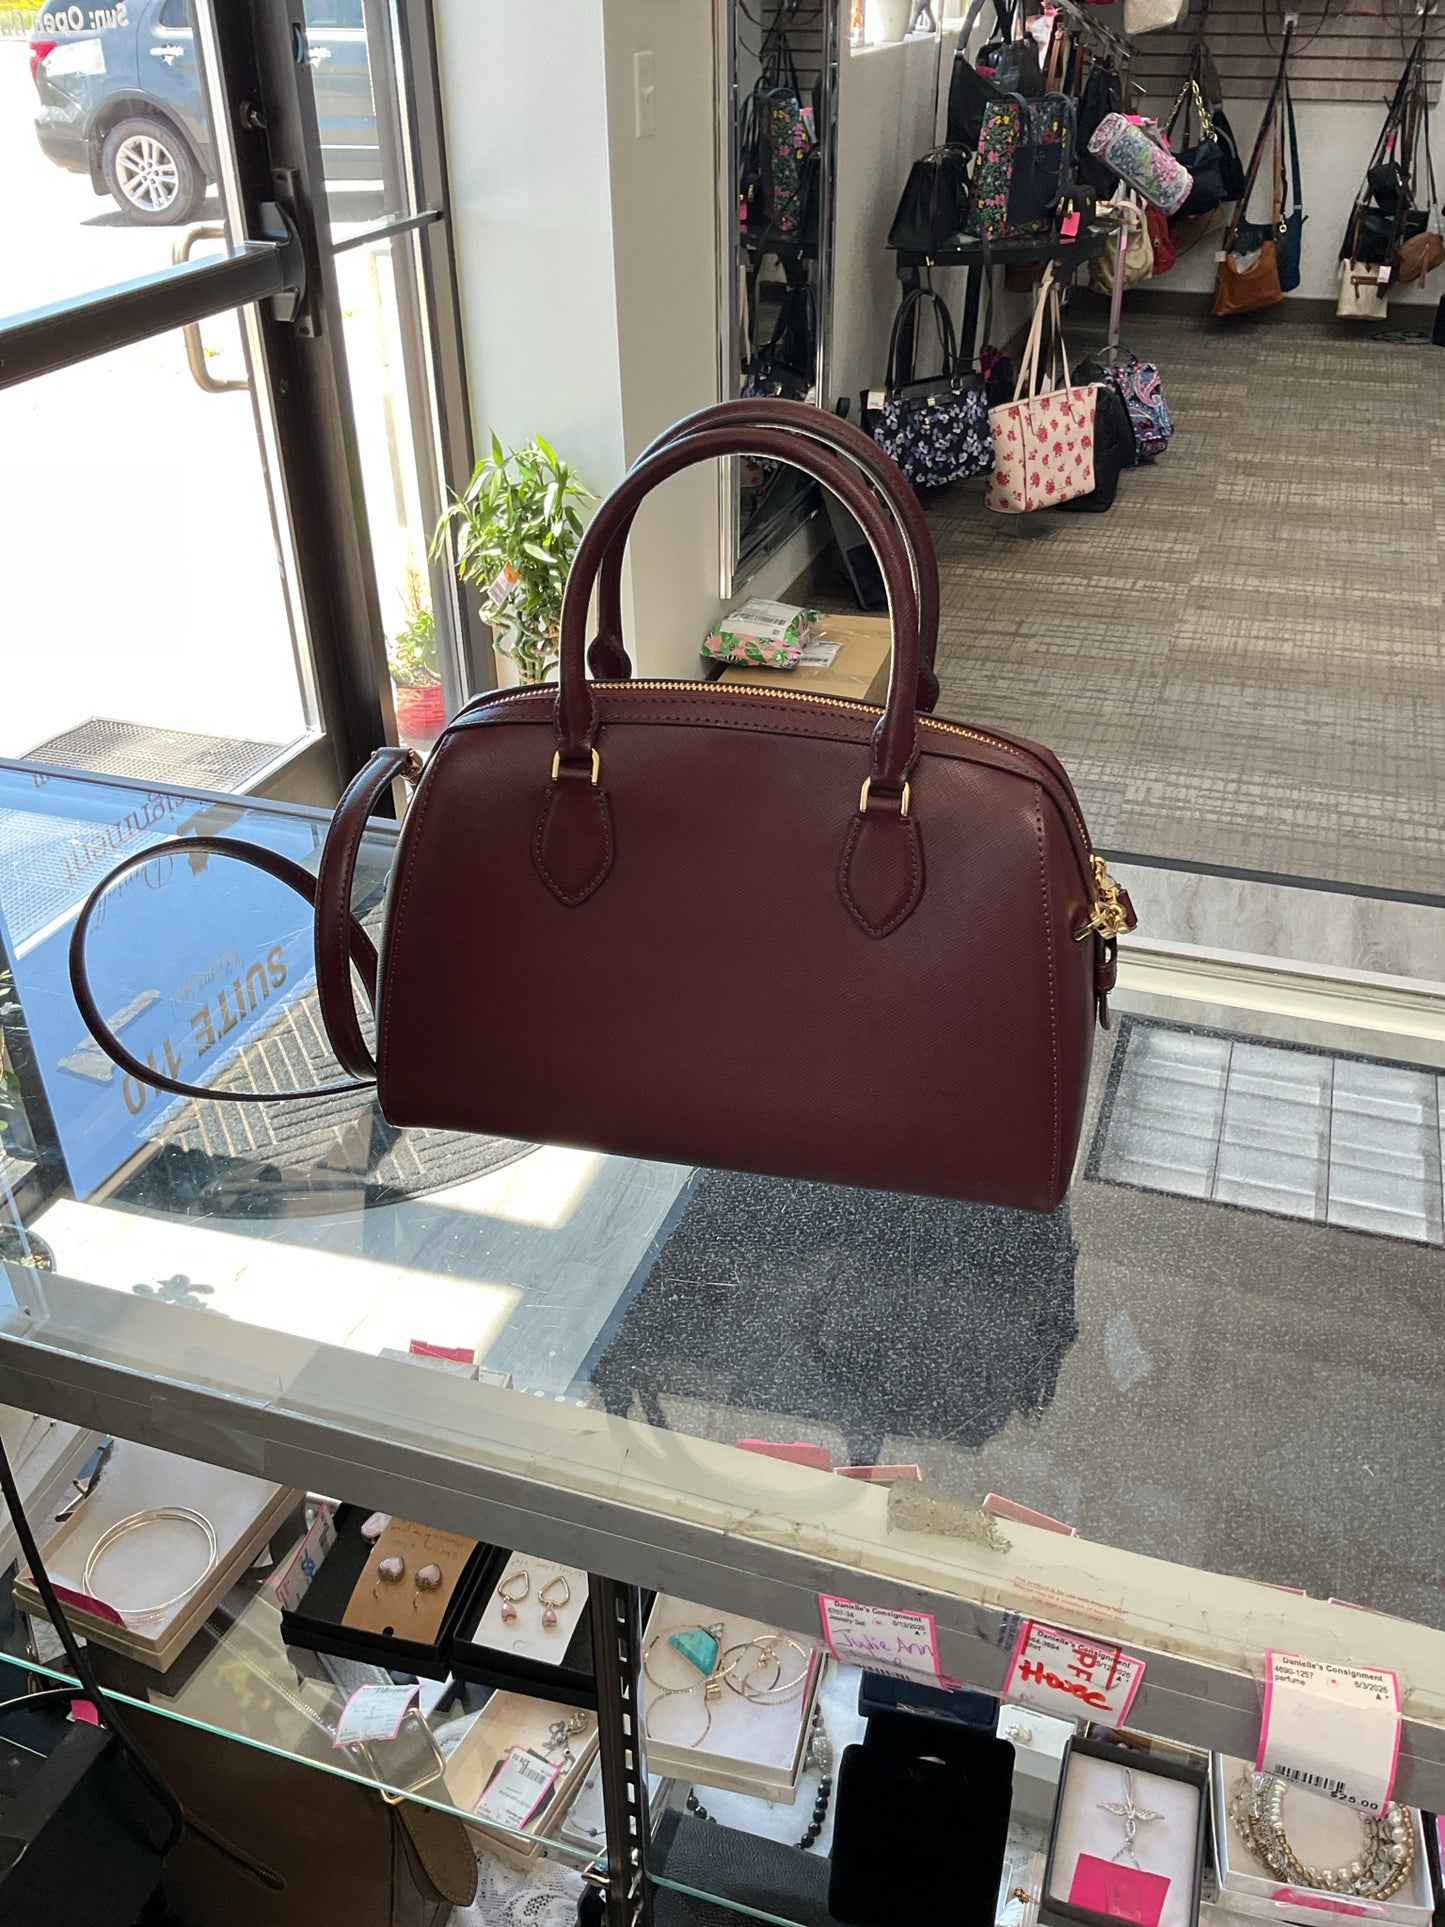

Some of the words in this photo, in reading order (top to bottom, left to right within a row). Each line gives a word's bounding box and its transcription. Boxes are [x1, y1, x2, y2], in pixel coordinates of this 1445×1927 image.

[190, 944, 288, 1058] SUITE
[834, 1600, 870, 1613] Danielle's
[872, 1606, 922, 1623] Consignment
[1036, 1630, 1076, 1648] Danielle's
[1274, 1673, 1306, 1687] perfume
[1282, 1656, 1324, 1672] Danielle's
[1326, 1665, 1384, 1683] Consignment
[1330, 1790, 1379, 1811] $25.00
